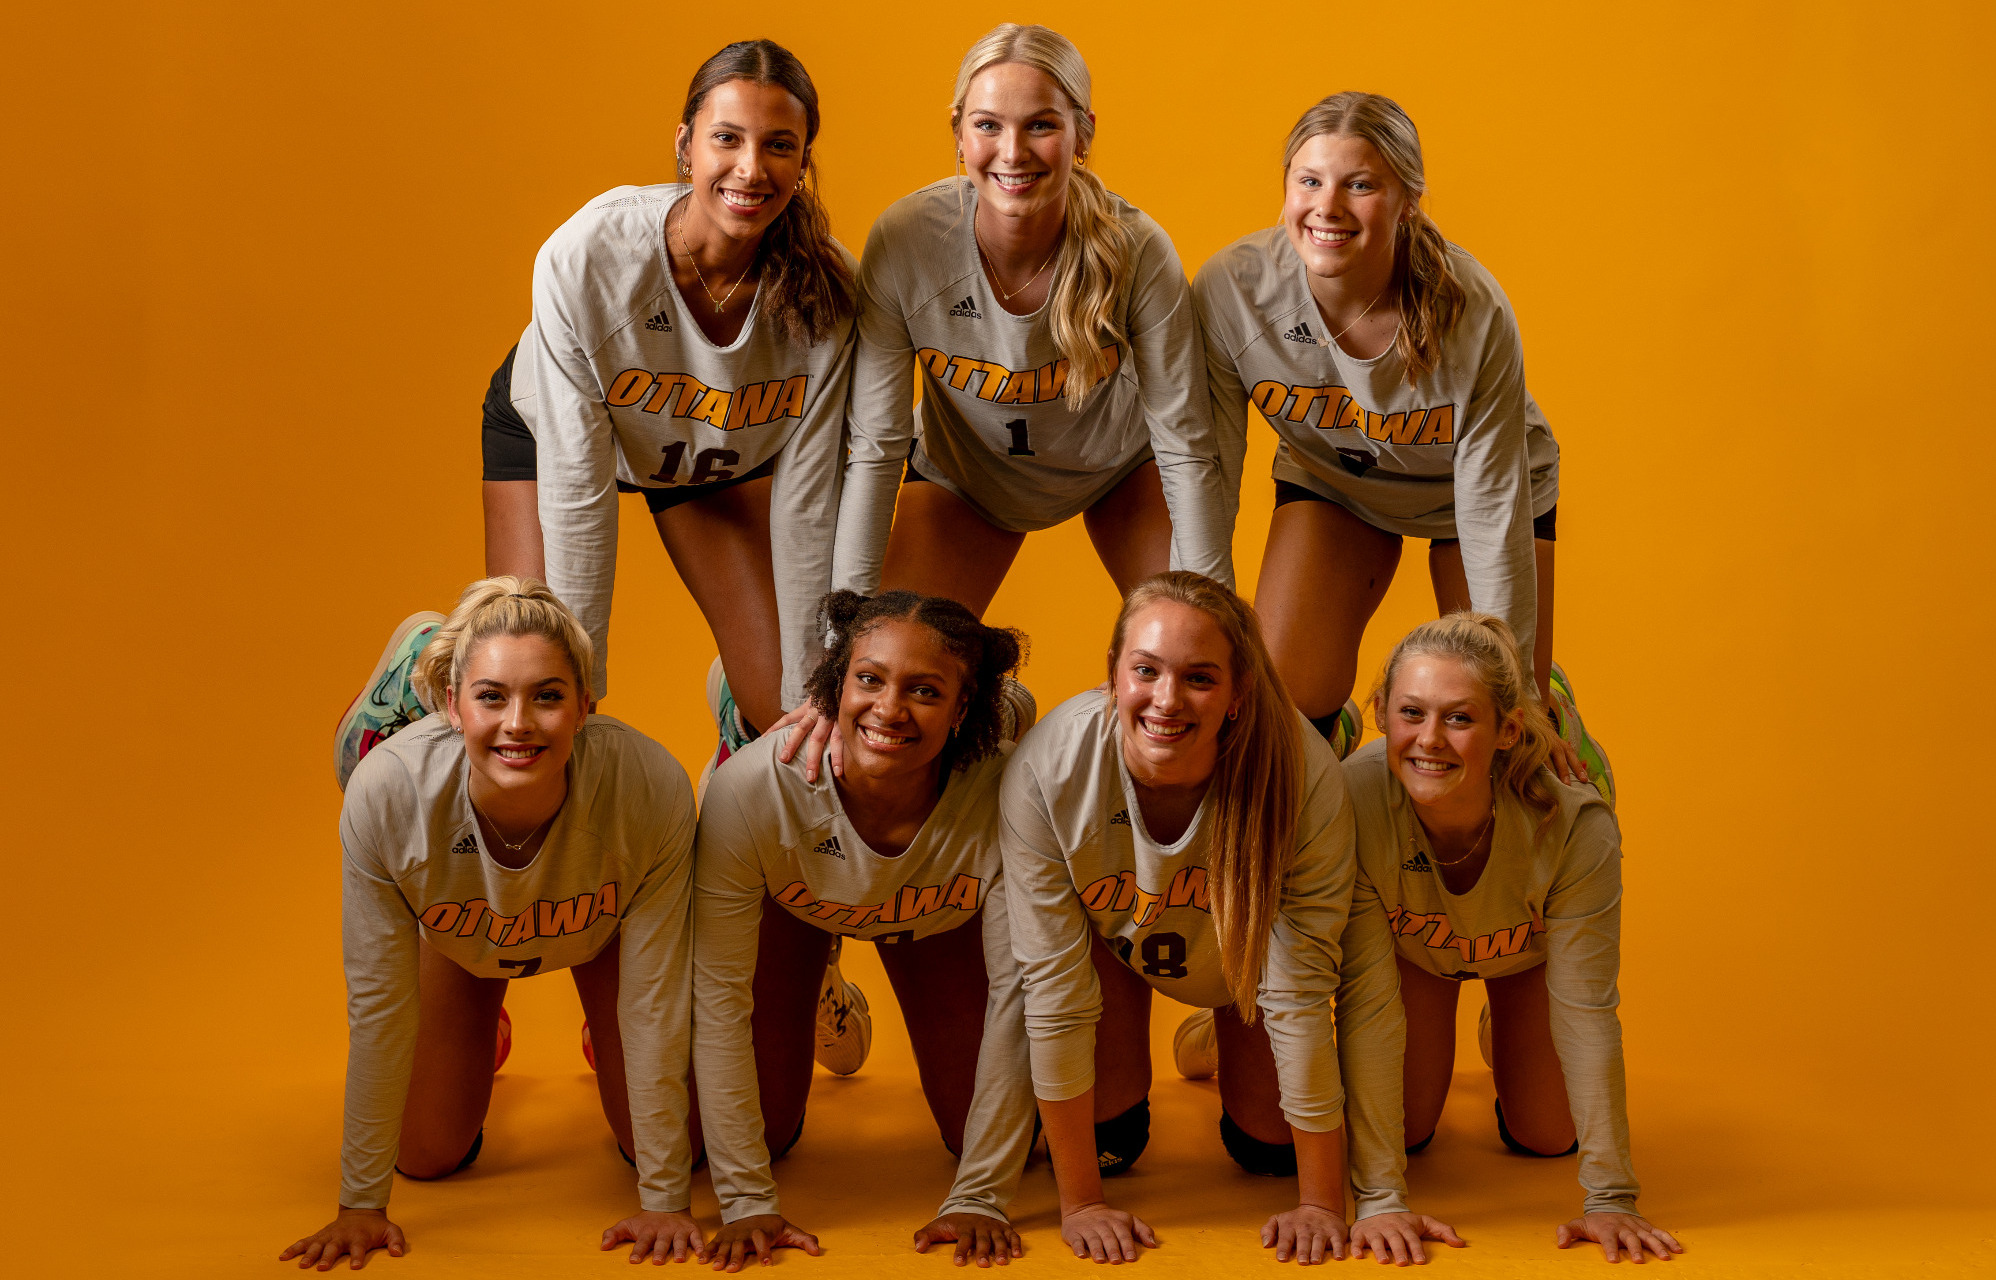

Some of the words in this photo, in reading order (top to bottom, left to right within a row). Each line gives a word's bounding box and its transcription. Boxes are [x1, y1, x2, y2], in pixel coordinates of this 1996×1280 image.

[645, 322, 672, 332] adidas
[949, 308, 982, 320] adidas
[1283, 331, 1317, 345] adidas
[606, 368, 809, 431] OTTAWA
[1250, 380, 1455, 446] OTTAWA
[1005, 418, 1036, 457] 1
[649, 441, 741, 485] 16
[451, 845, 480, 854] adida
[813, 844, 846, 861] adidas
[418, 881, 618, 948] OTTAWA
[773, 872, 982, 929] OTTAWA
[1079, 865, 1212, 928] OTTAW
